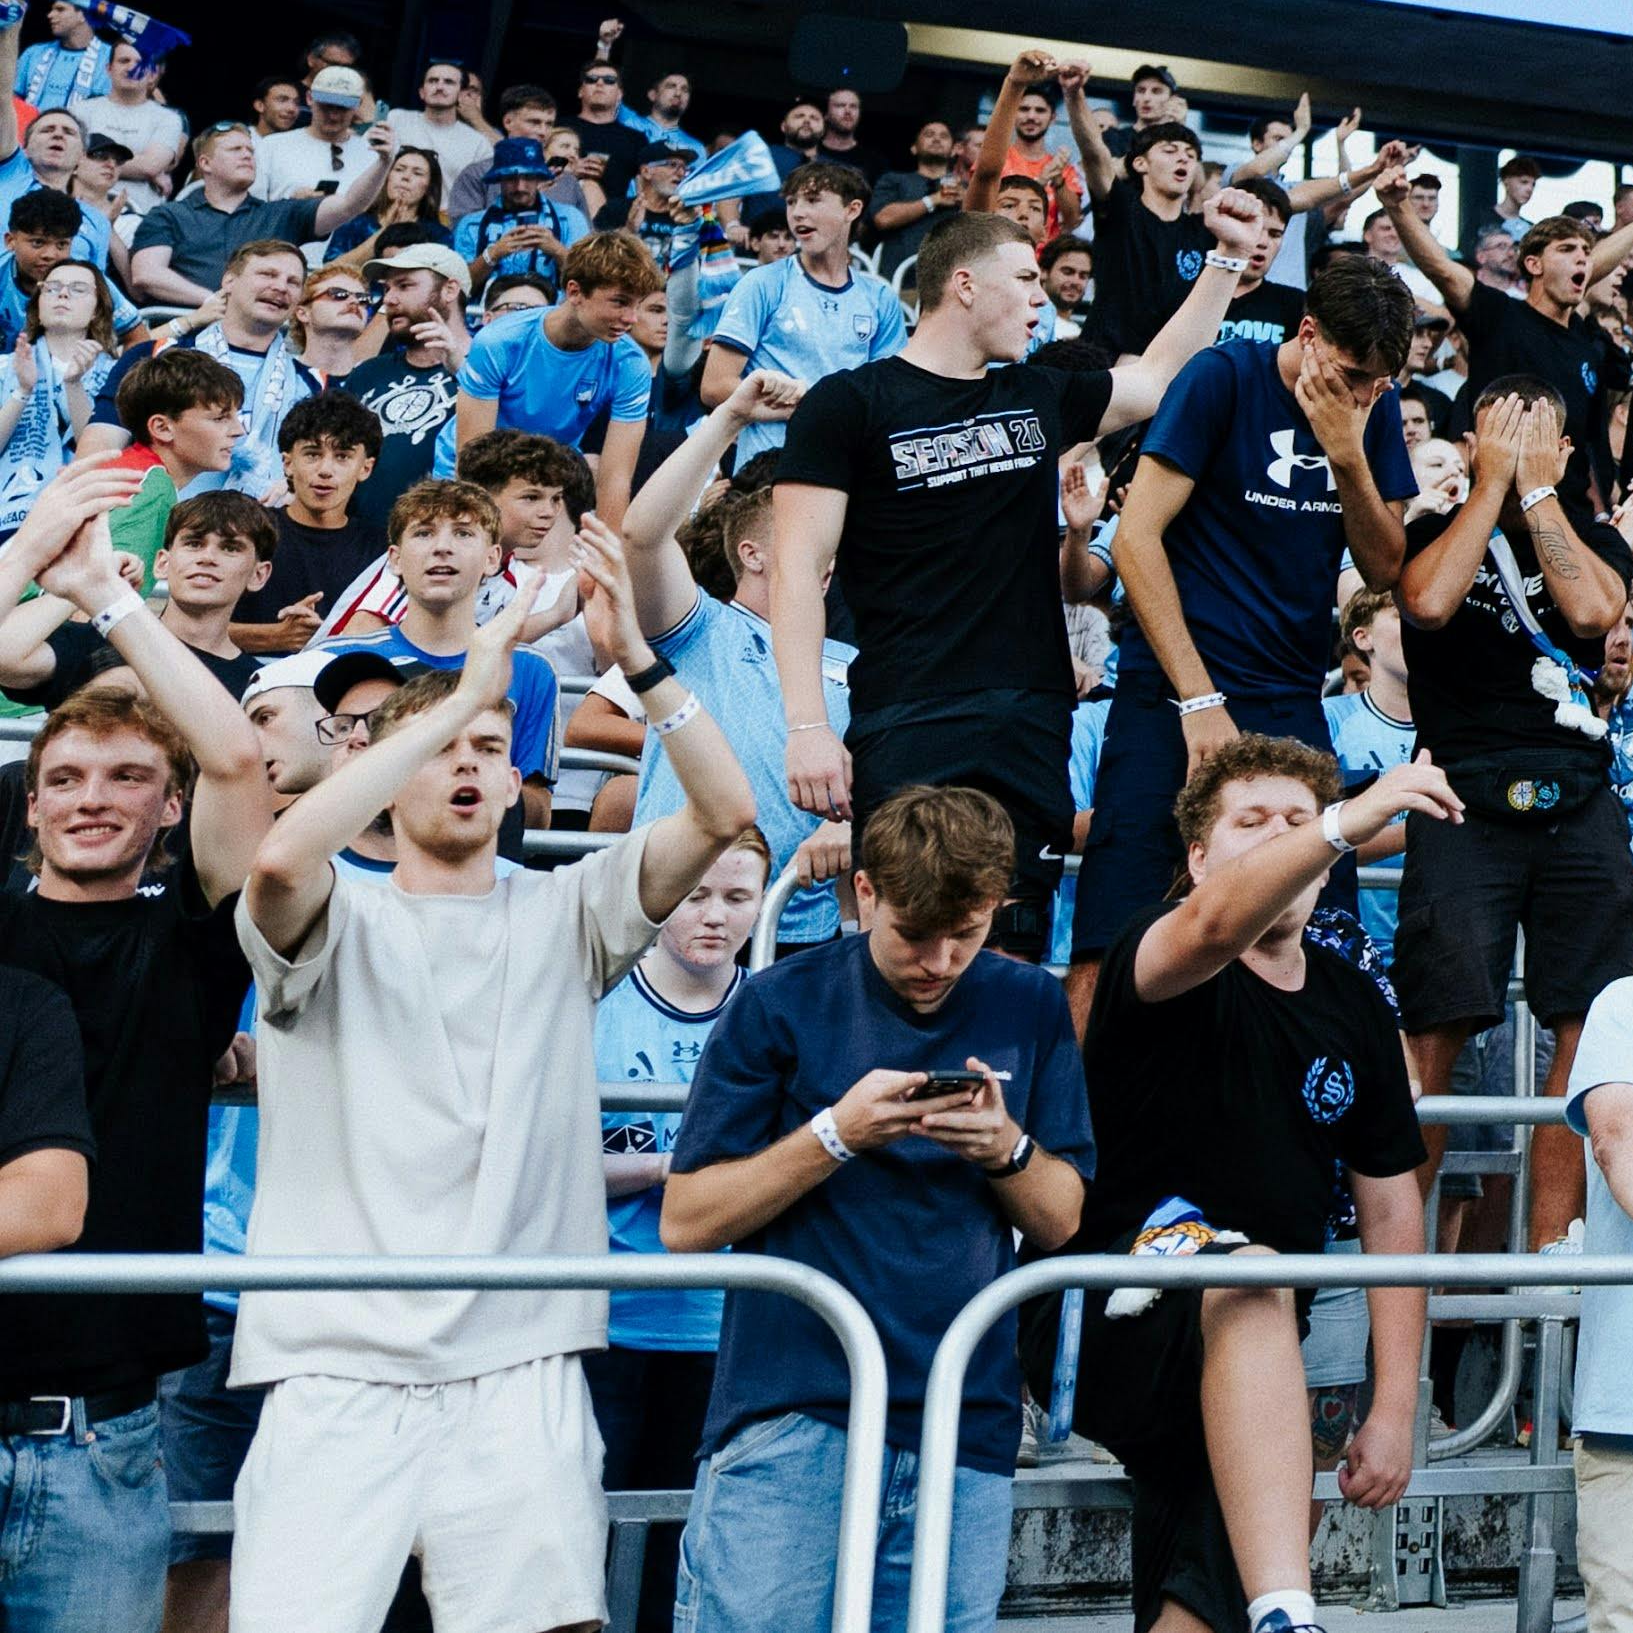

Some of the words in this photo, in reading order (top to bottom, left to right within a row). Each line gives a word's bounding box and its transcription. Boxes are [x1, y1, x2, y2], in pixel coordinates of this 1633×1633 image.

[890, 422, 1014, 479] SEASON
[1009, 417, 1047, 452] 20
[926, 470, 967, 488] SUPPORT
[1245, 490, 1296, 511] UNDER
[1301, 500, 1344, 514] ARMO
